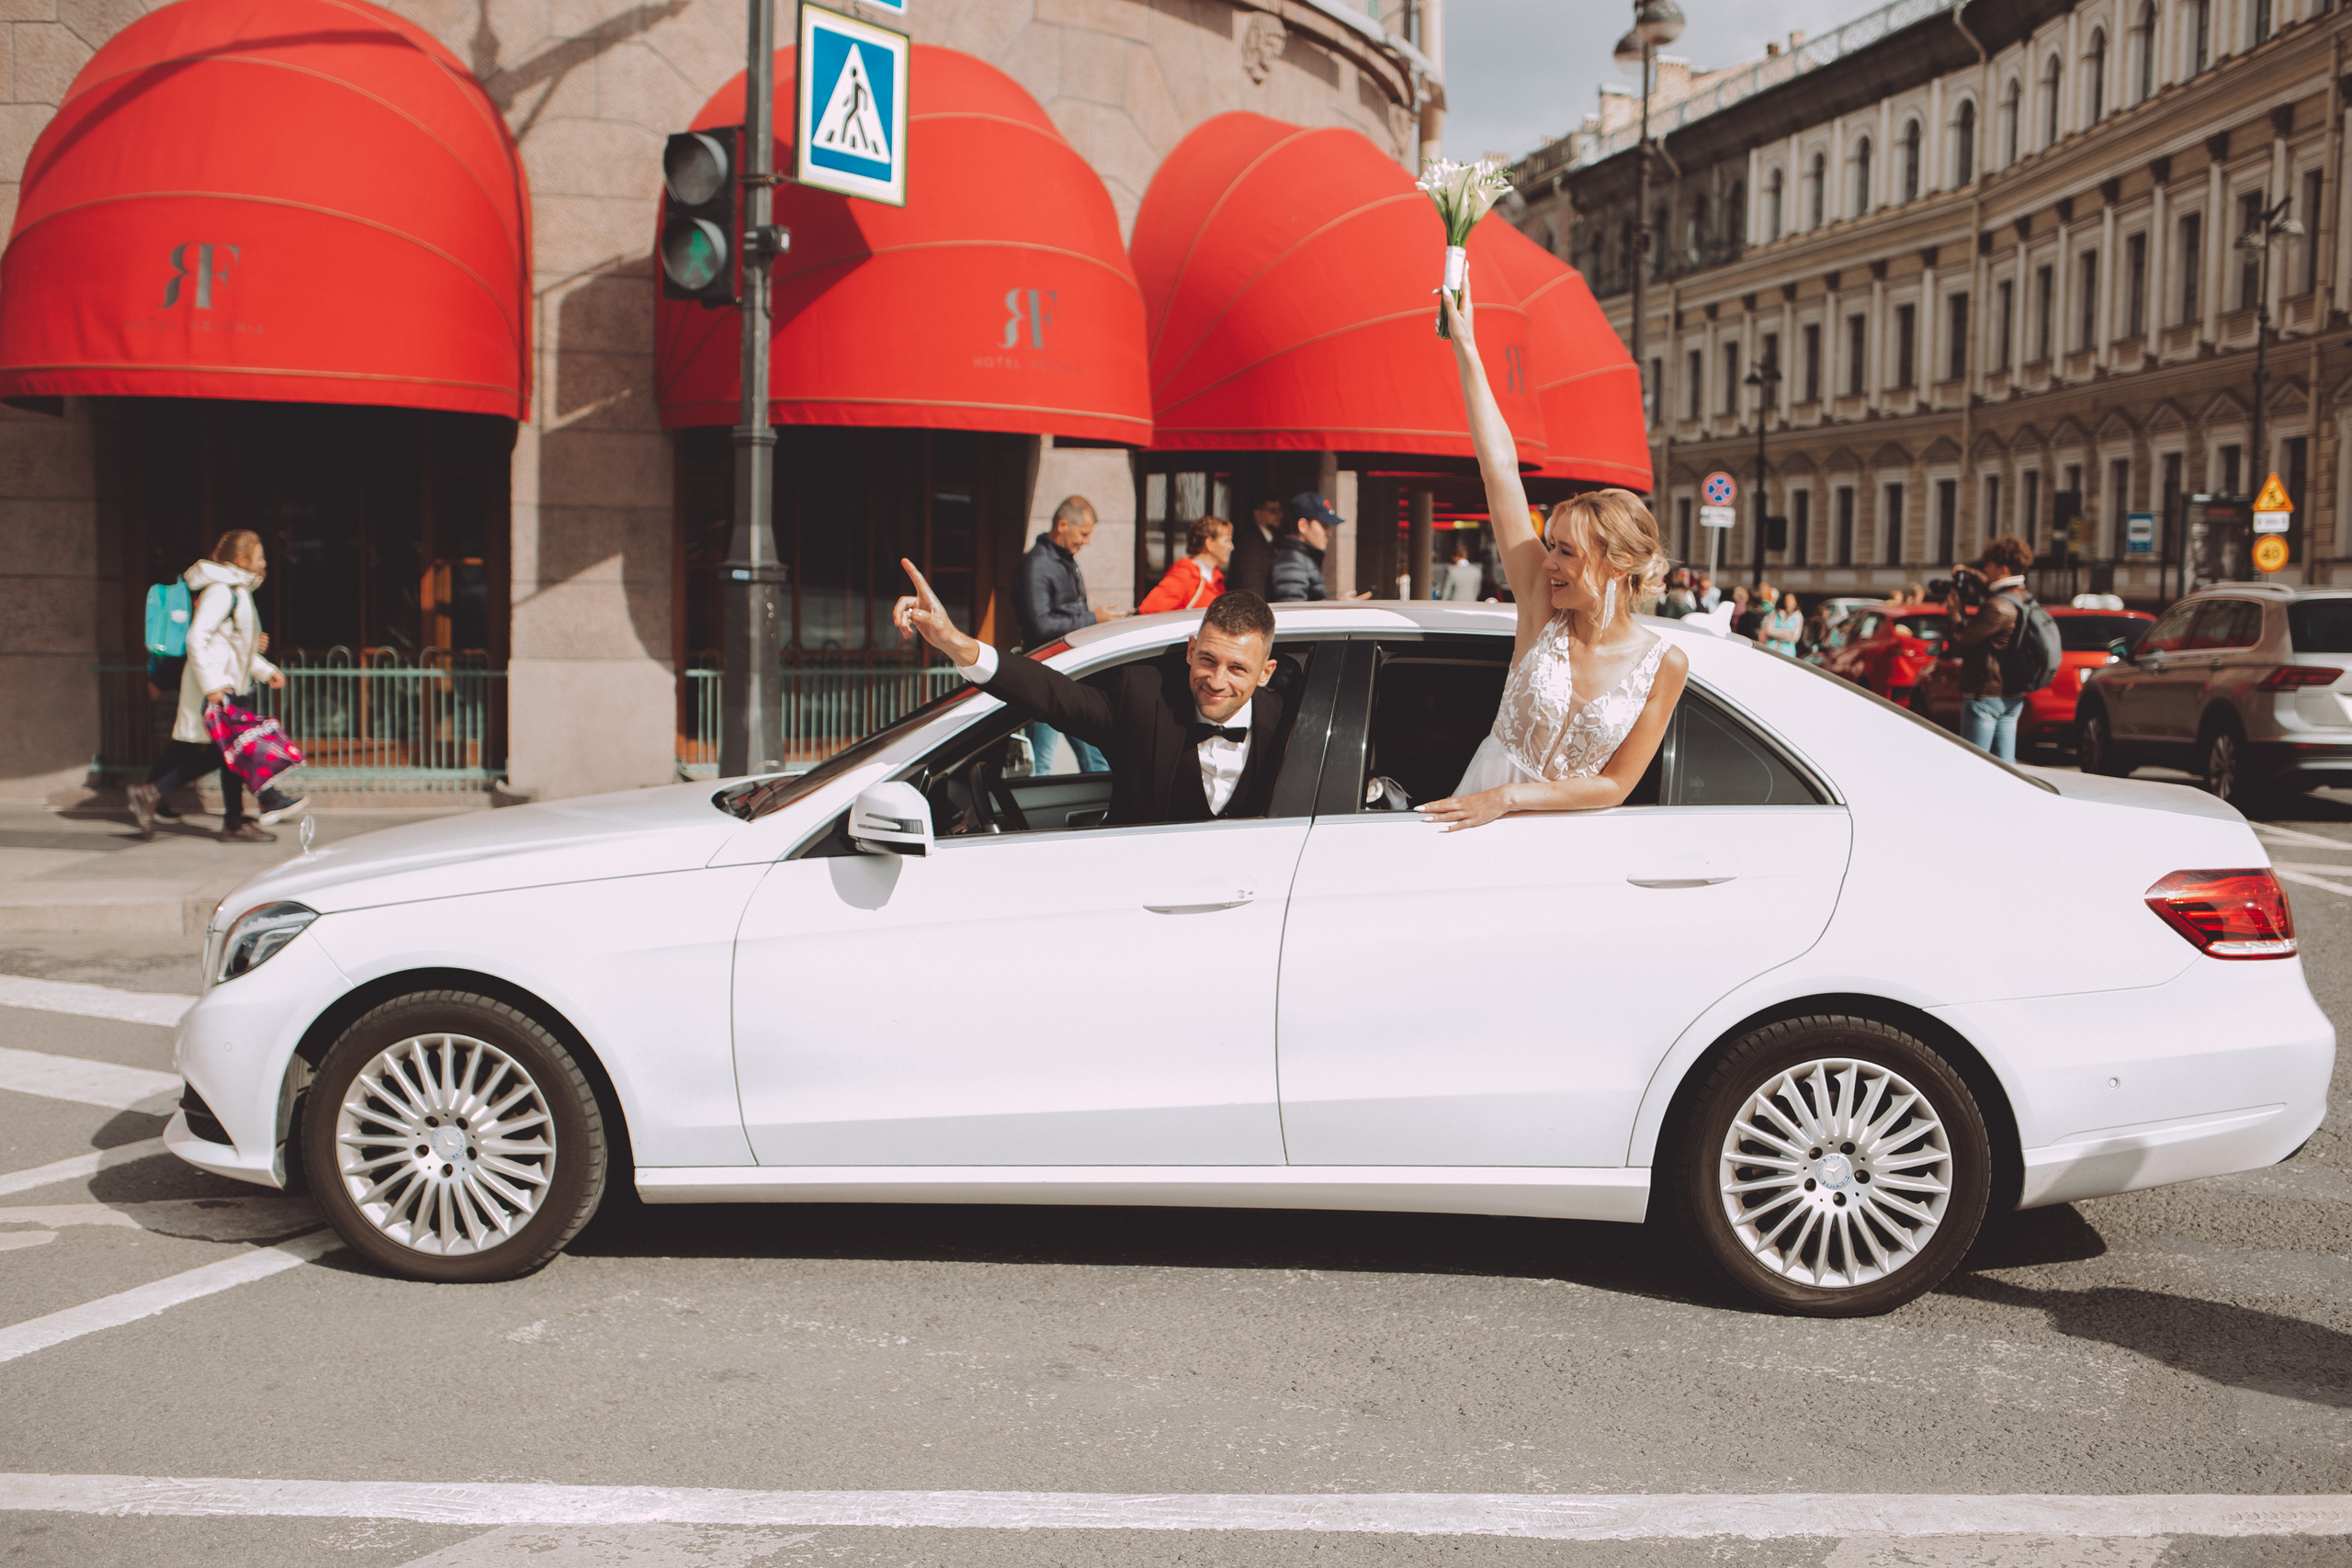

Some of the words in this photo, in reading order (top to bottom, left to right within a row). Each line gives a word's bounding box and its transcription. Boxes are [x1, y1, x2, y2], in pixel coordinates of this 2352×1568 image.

[123, 318, 177, 333] HOTEL
[188, 320, 264, 336] ASTORIA
[972, 355, 1021, 370] HOTEL
[2261, 546, 2280, 559] 40
